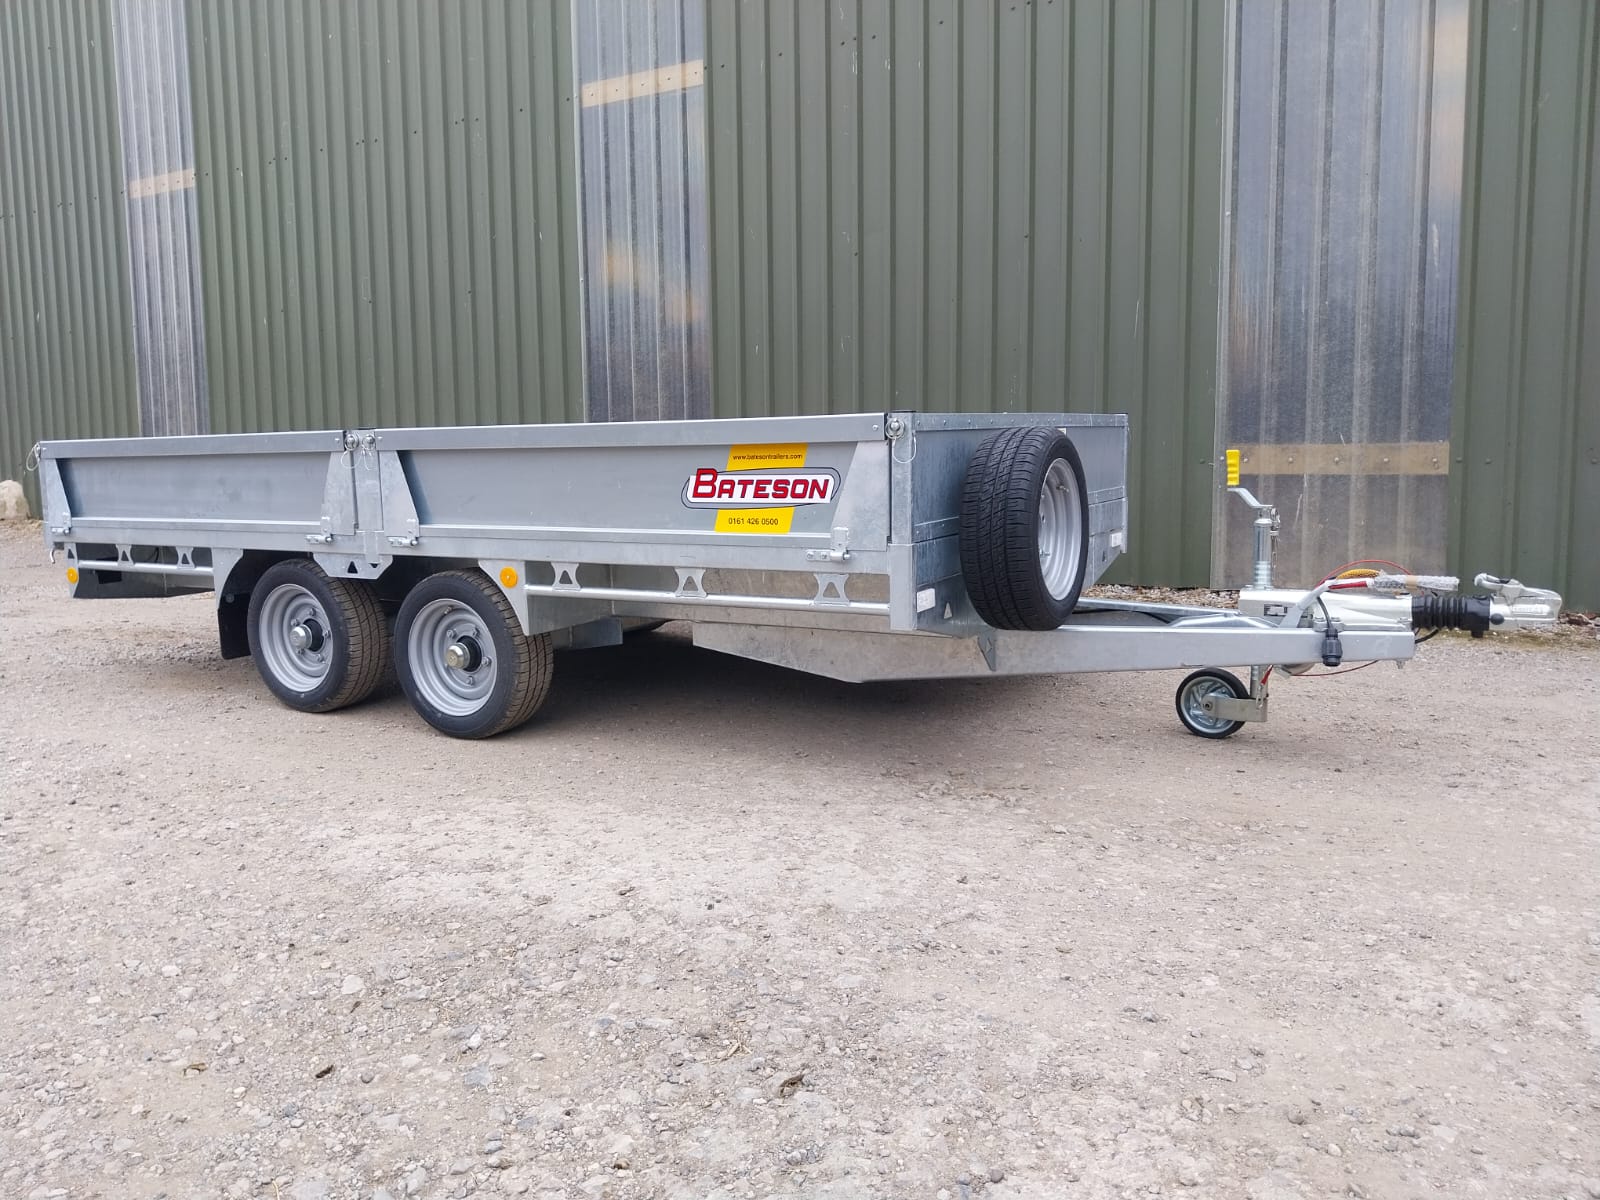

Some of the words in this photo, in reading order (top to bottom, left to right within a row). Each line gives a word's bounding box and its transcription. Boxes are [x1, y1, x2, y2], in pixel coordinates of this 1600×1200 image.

[692, 468, 830, 499] BATESON
[728, 517, 745, 525] 0161
[747, 517, 760, 525] 426
[761, 517, 779, 526] 0500
